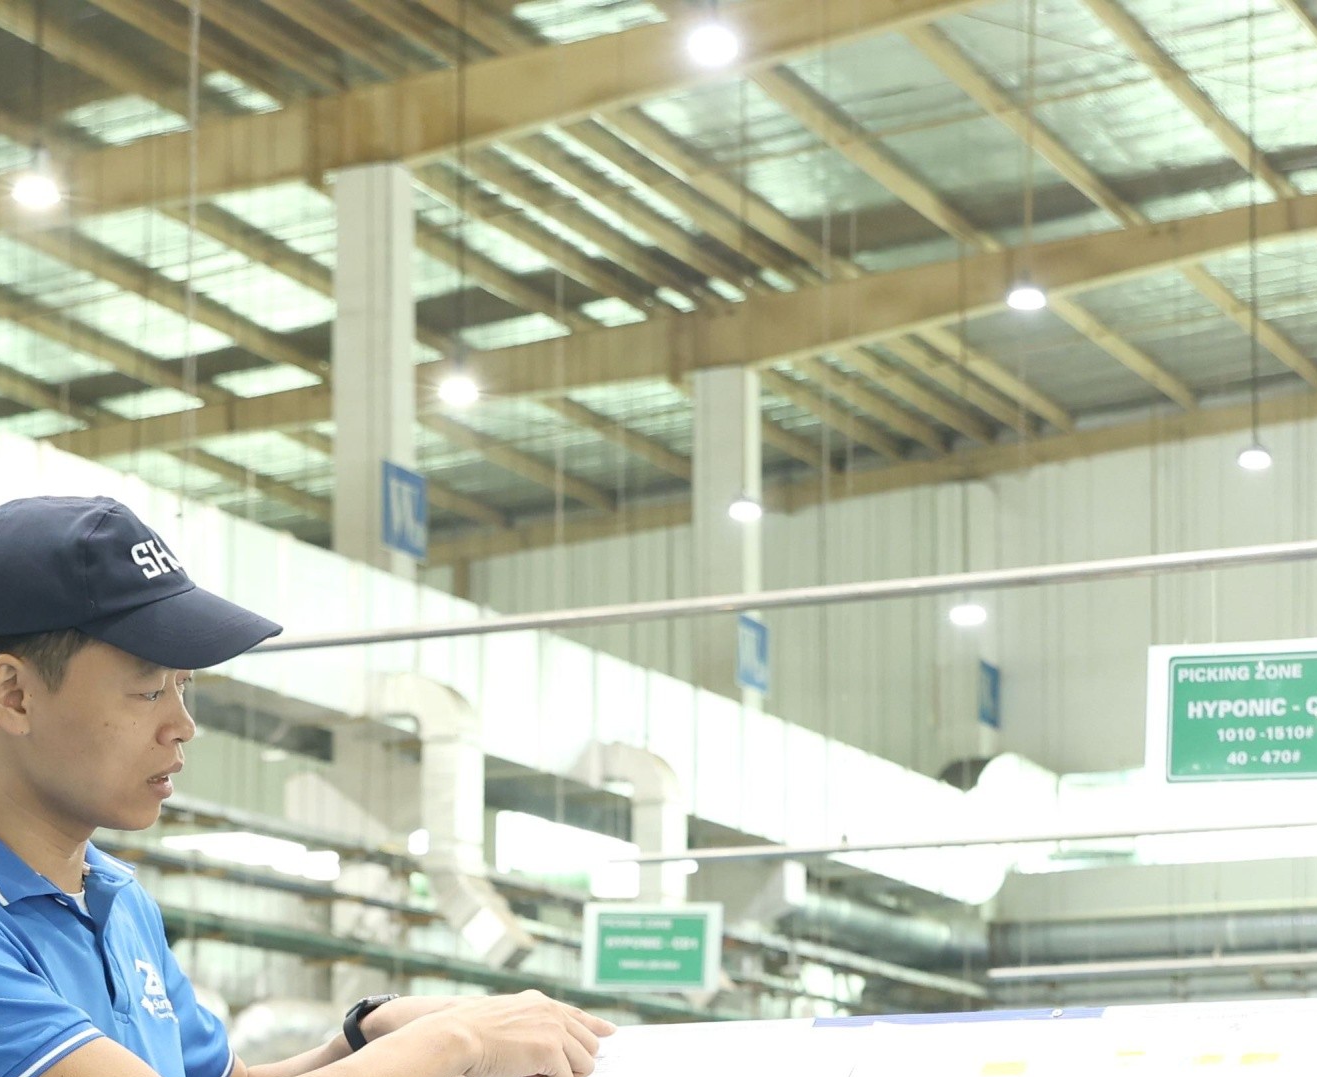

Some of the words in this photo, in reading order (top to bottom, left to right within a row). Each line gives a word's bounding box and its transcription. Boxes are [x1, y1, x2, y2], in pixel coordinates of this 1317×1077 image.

[131, 538, 182, 579] SH
[1178, 666, 1250, 684] PICKING
[1254, 663, 1303, 680] ZONE
[1187, 697, 1287, 720] HYPONIC
[1217, 727, 1256, 742] 1010
[1227, 751, 1248, 765] 40
